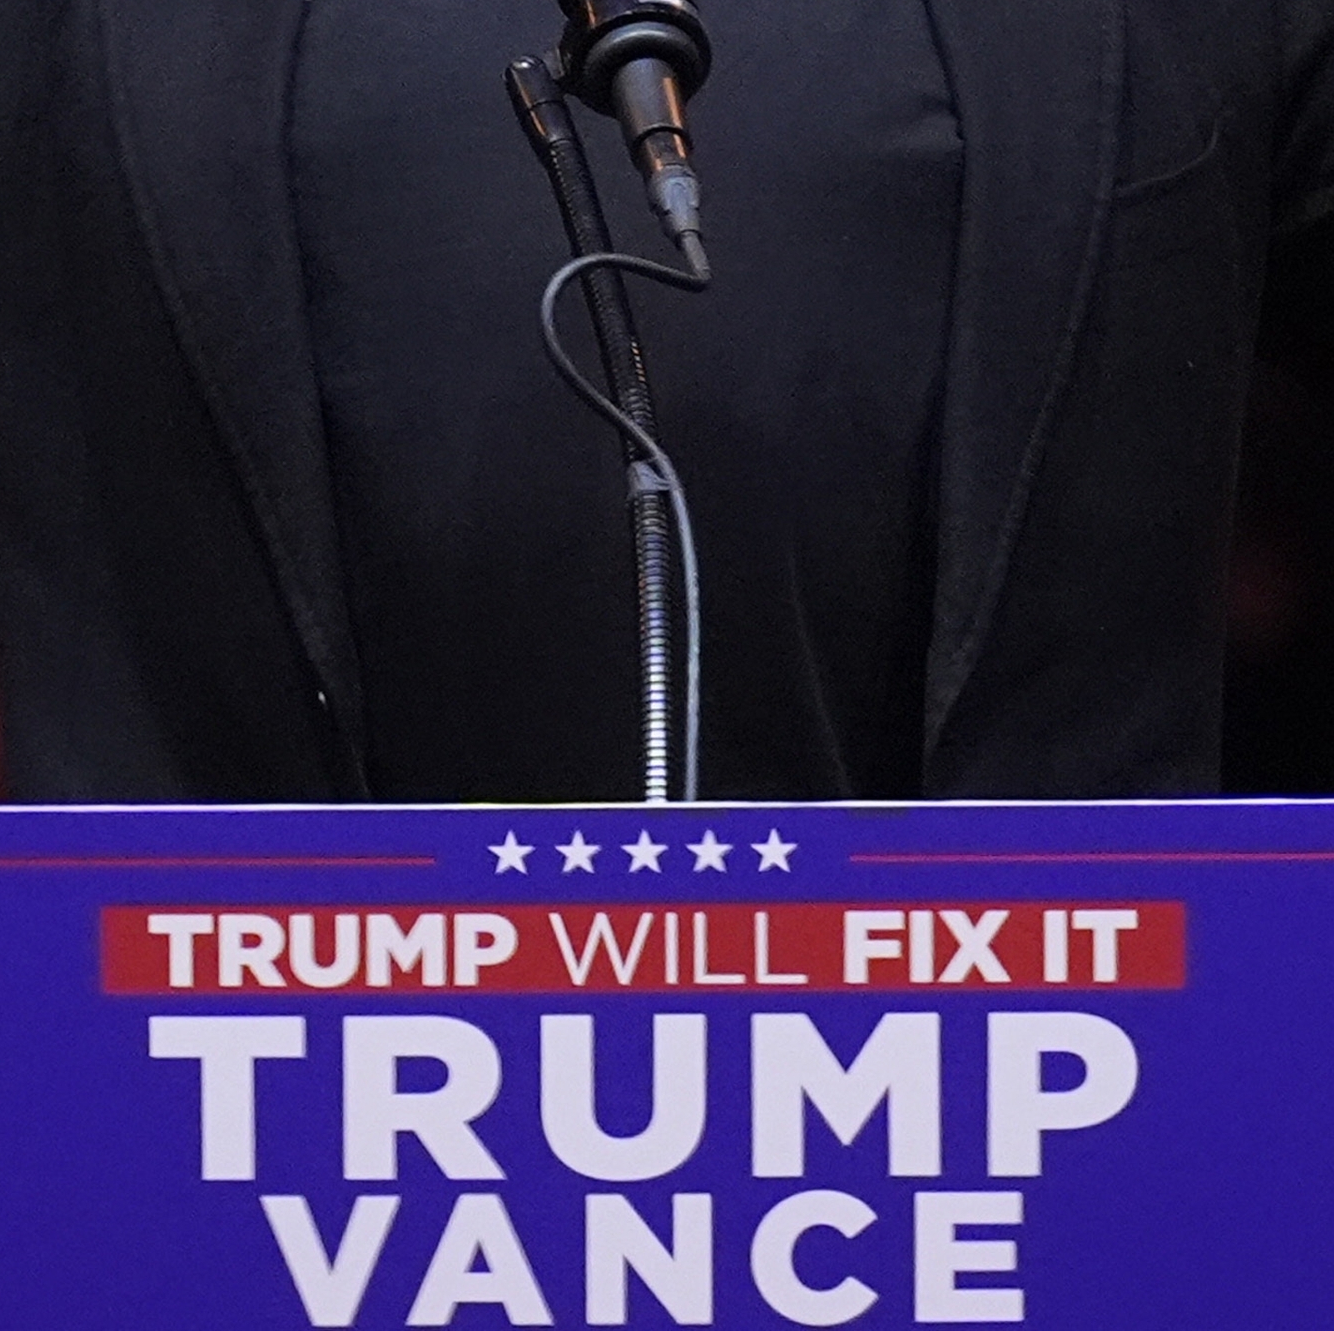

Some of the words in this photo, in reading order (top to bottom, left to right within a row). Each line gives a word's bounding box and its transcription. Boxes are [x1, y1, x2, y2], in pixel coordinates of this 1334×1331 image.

[147, 913, 518, 988] TRUMP
[548, 911, 809, 986] WILL
[842, 909, 1010, 984] FIX
[1043, 909, 1138, 983] IT
[148, 1011, 1138, 1182] TRUMP
[259, 1189, 1024, 1328] VANCE
